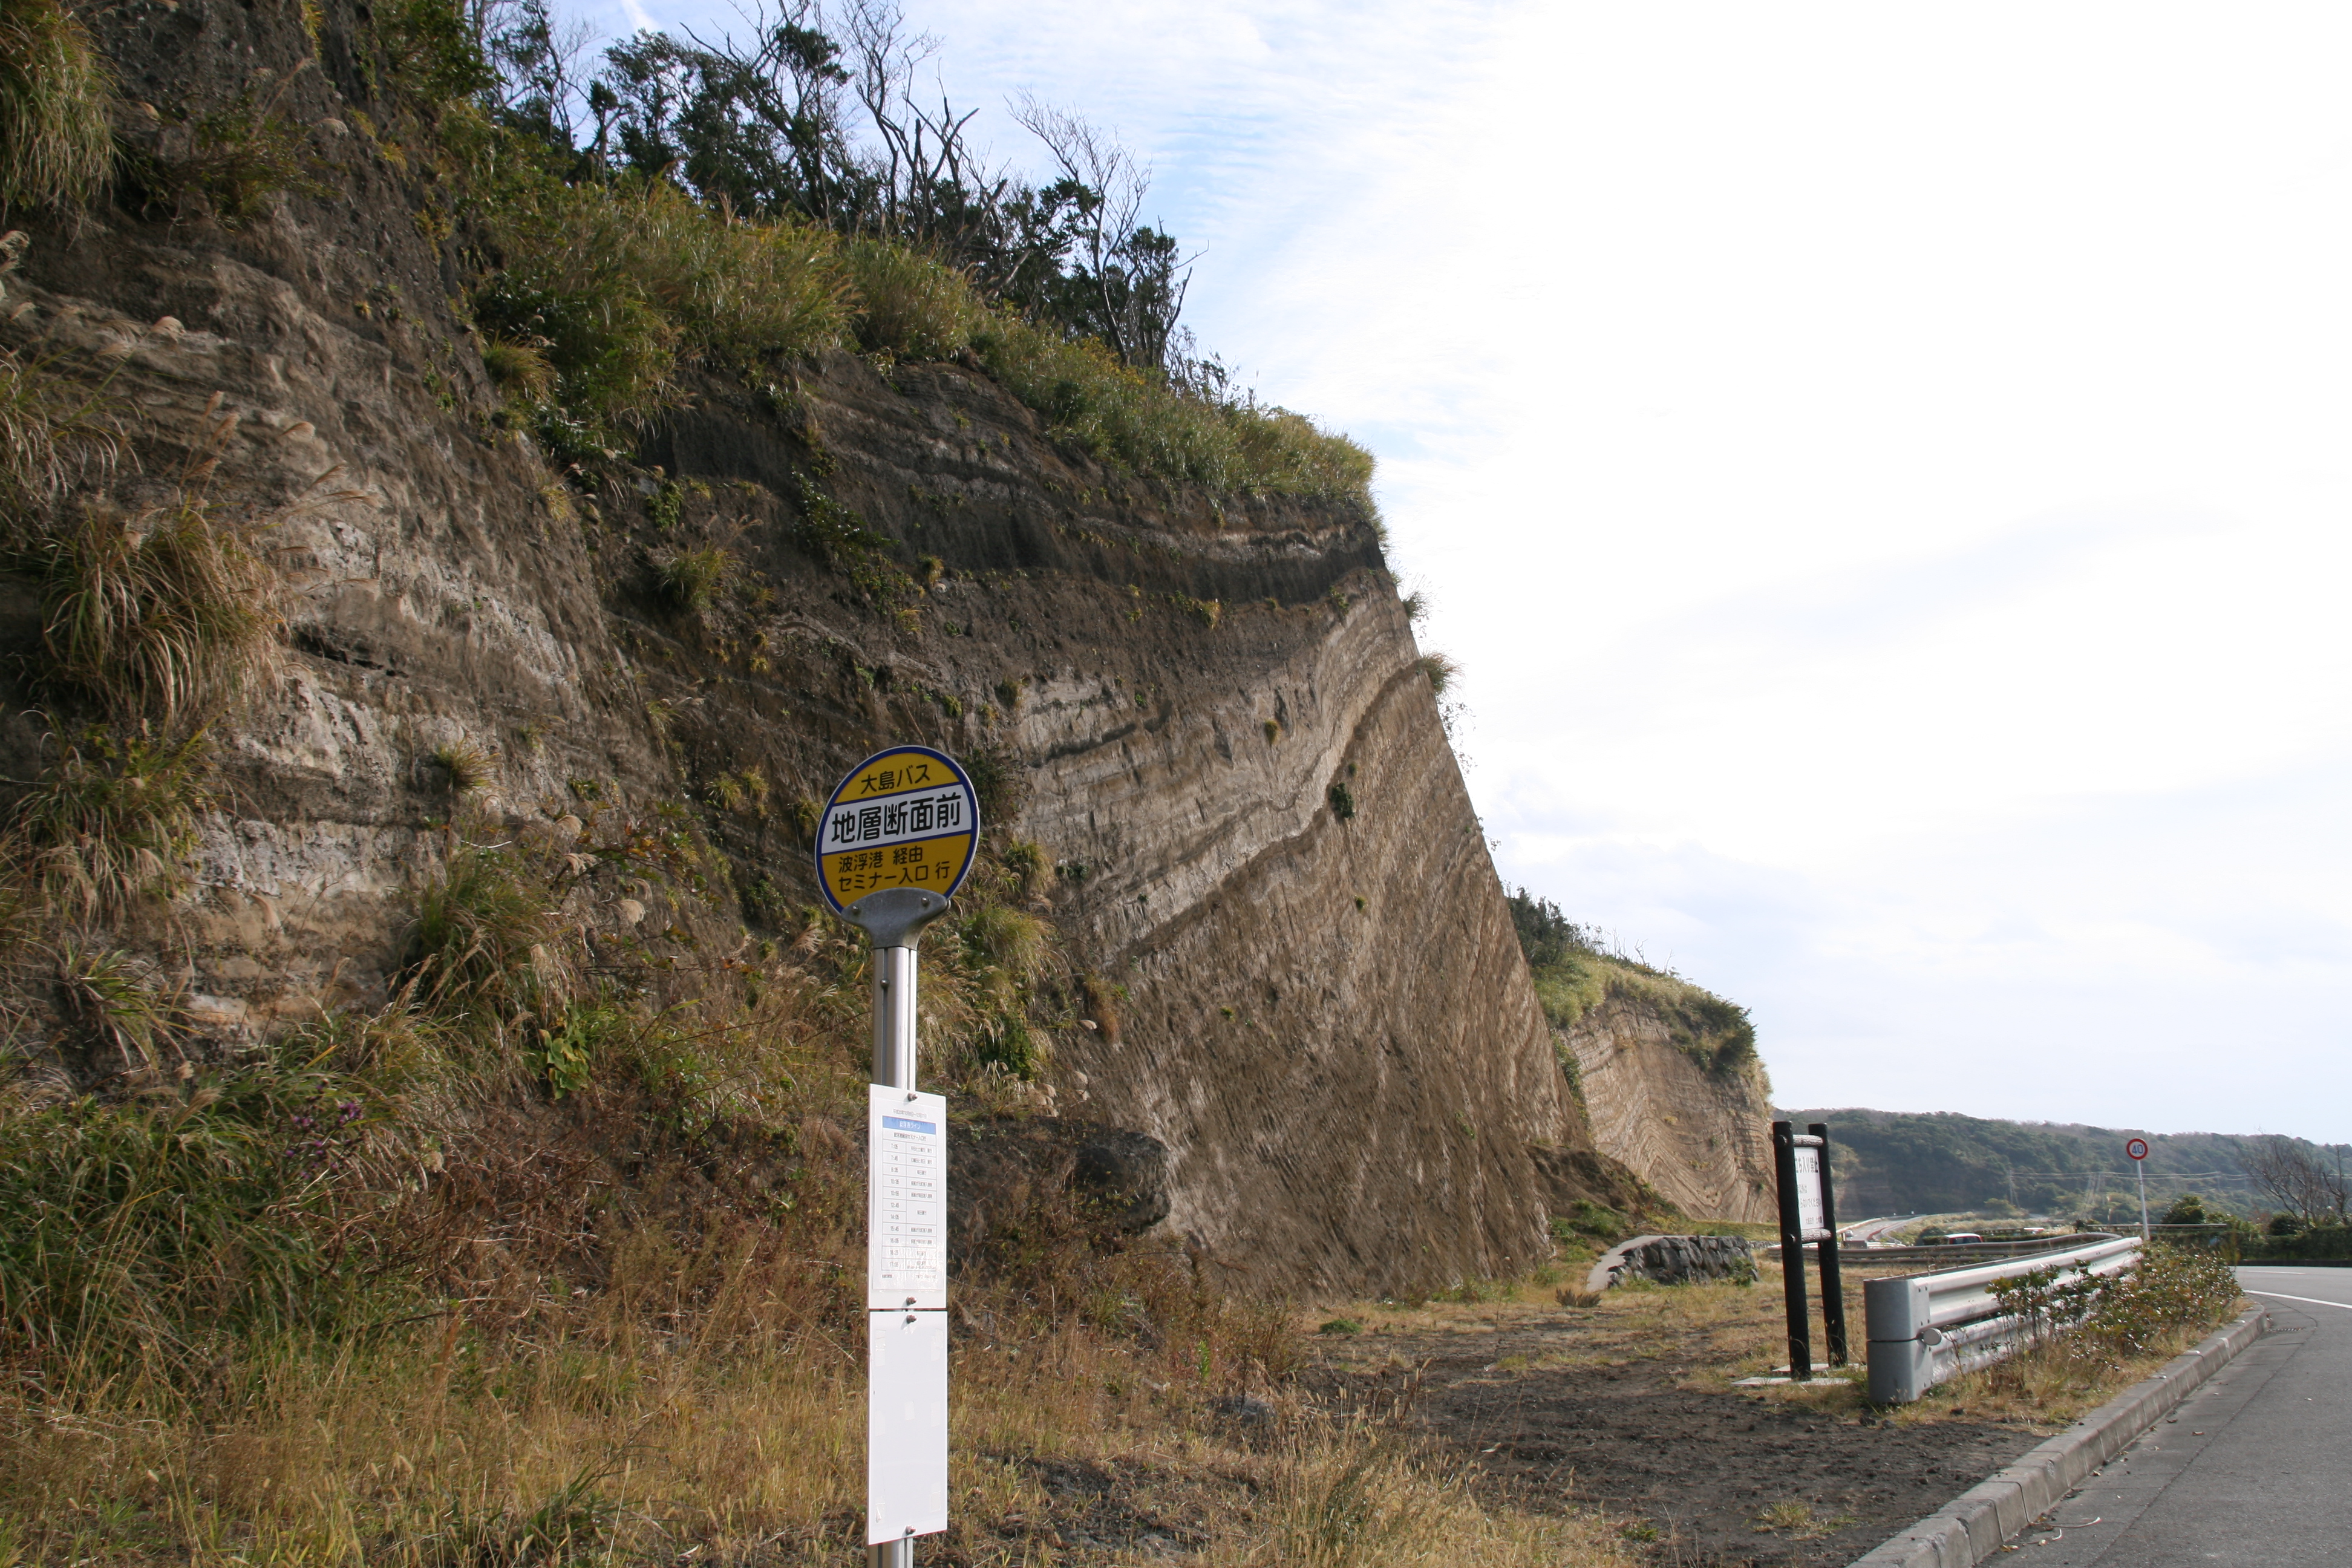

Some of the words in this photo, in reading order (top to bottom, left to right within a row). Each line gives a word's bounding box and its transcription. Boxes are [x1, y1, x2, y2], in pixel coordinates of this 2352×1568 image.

[861, 764, 930, 794] 大島バス
[831, 792, 961, 843] 地層断面前
[838, 851, 883, 873] 波浮港
[893, 846, 923, 865] 経由
[838, 865, 929, 892] セミナー入口
[935, 861, 950, 880] 行
[2132, 1144, 2143, 1154] 40
